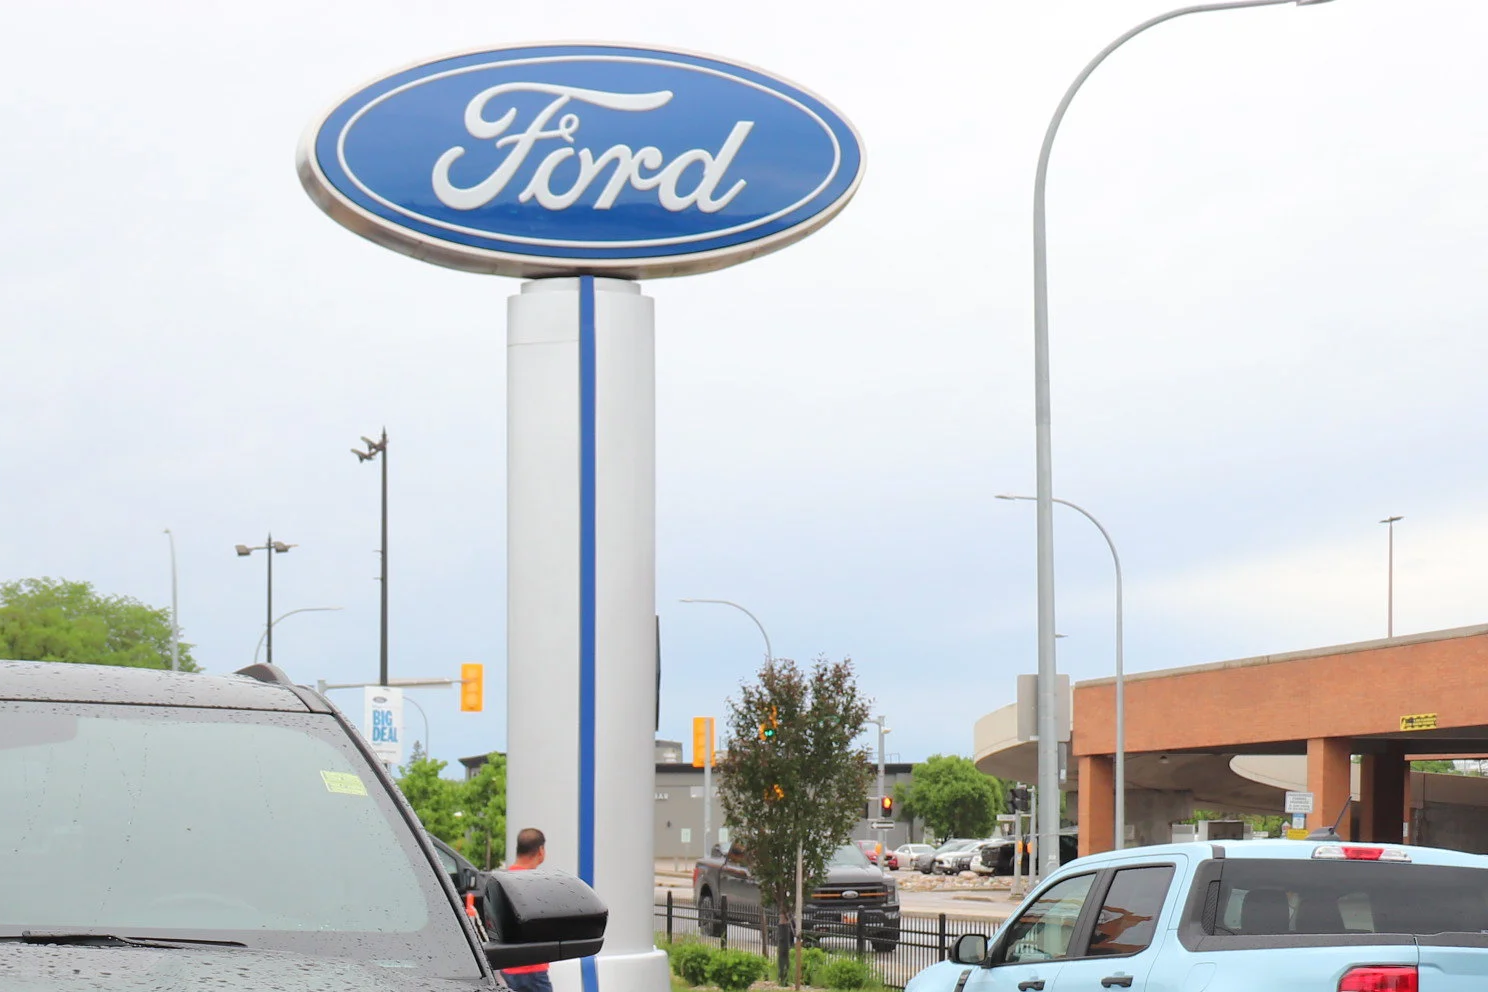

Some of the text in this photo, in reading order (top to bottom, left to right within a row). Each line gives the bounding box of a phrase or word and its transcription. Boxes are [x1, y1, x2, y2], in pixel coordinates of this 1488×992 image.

[431, 81, 755, 213] Ford
[373, 710, 393, 726] BIG
[373, 726, 398, 743] DEAL
